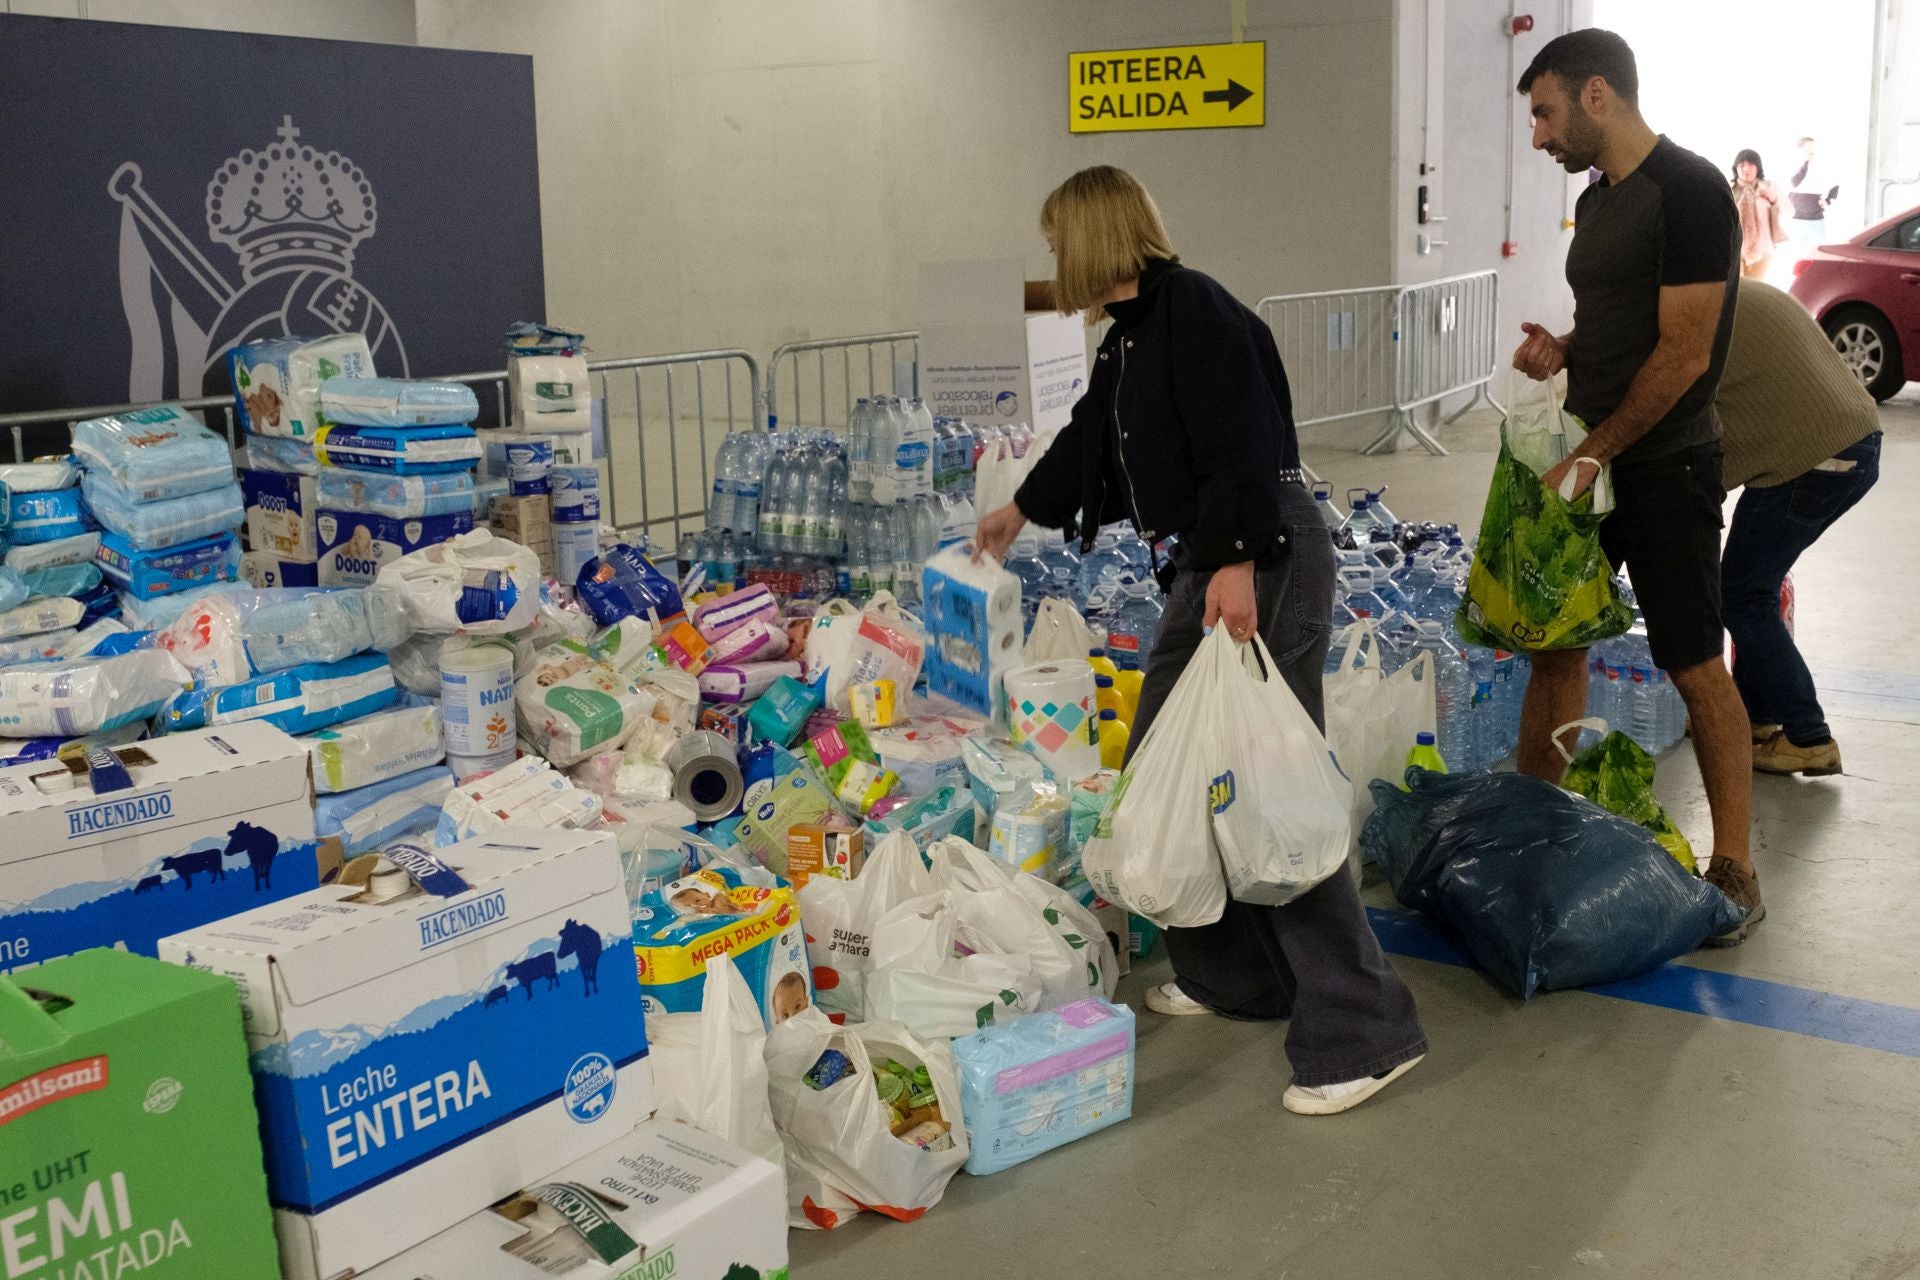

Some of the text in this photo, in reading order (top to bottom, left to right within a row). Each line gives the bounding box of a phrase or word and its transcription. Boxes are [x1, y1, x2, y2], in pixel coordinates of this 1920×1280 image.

[1080, 55, 1206, 85] IRTEERA
[1079, 91, 1189, 120] SALIDA
[932, 391, 993, 402] relocation
[935, 401, 994, 416] premier
[257, 490, 287, 513] DODOT
[453, 516, 461, 530] 2
[335, 553, 377, 576] DODOT
[564, 692, 596, 718] Pants
[487, 733, 497, 749] 2
[68, 795, 171, 834] HACENDADO
[759, 804, 775, 819] Hero
[420, 894, 506, 946] HACENDADO
[691, 918, 771, 967] MEGA PACK
[570, 1058, 602, 1087] 100%
[321, 1063, 398, 1116] Leche
[326, 1059, 492, 1170] ENTERA
[33, 1150, 91, 1191] UHT
[617, 1156, 700, 1194] SEMIDESNATADA
[630, 1174, 665, 1191] LECHE
[635, 1153, 703, 1184] UHT DE VACA
[600, 1177, 659, 1205] 6x1 LITRO
